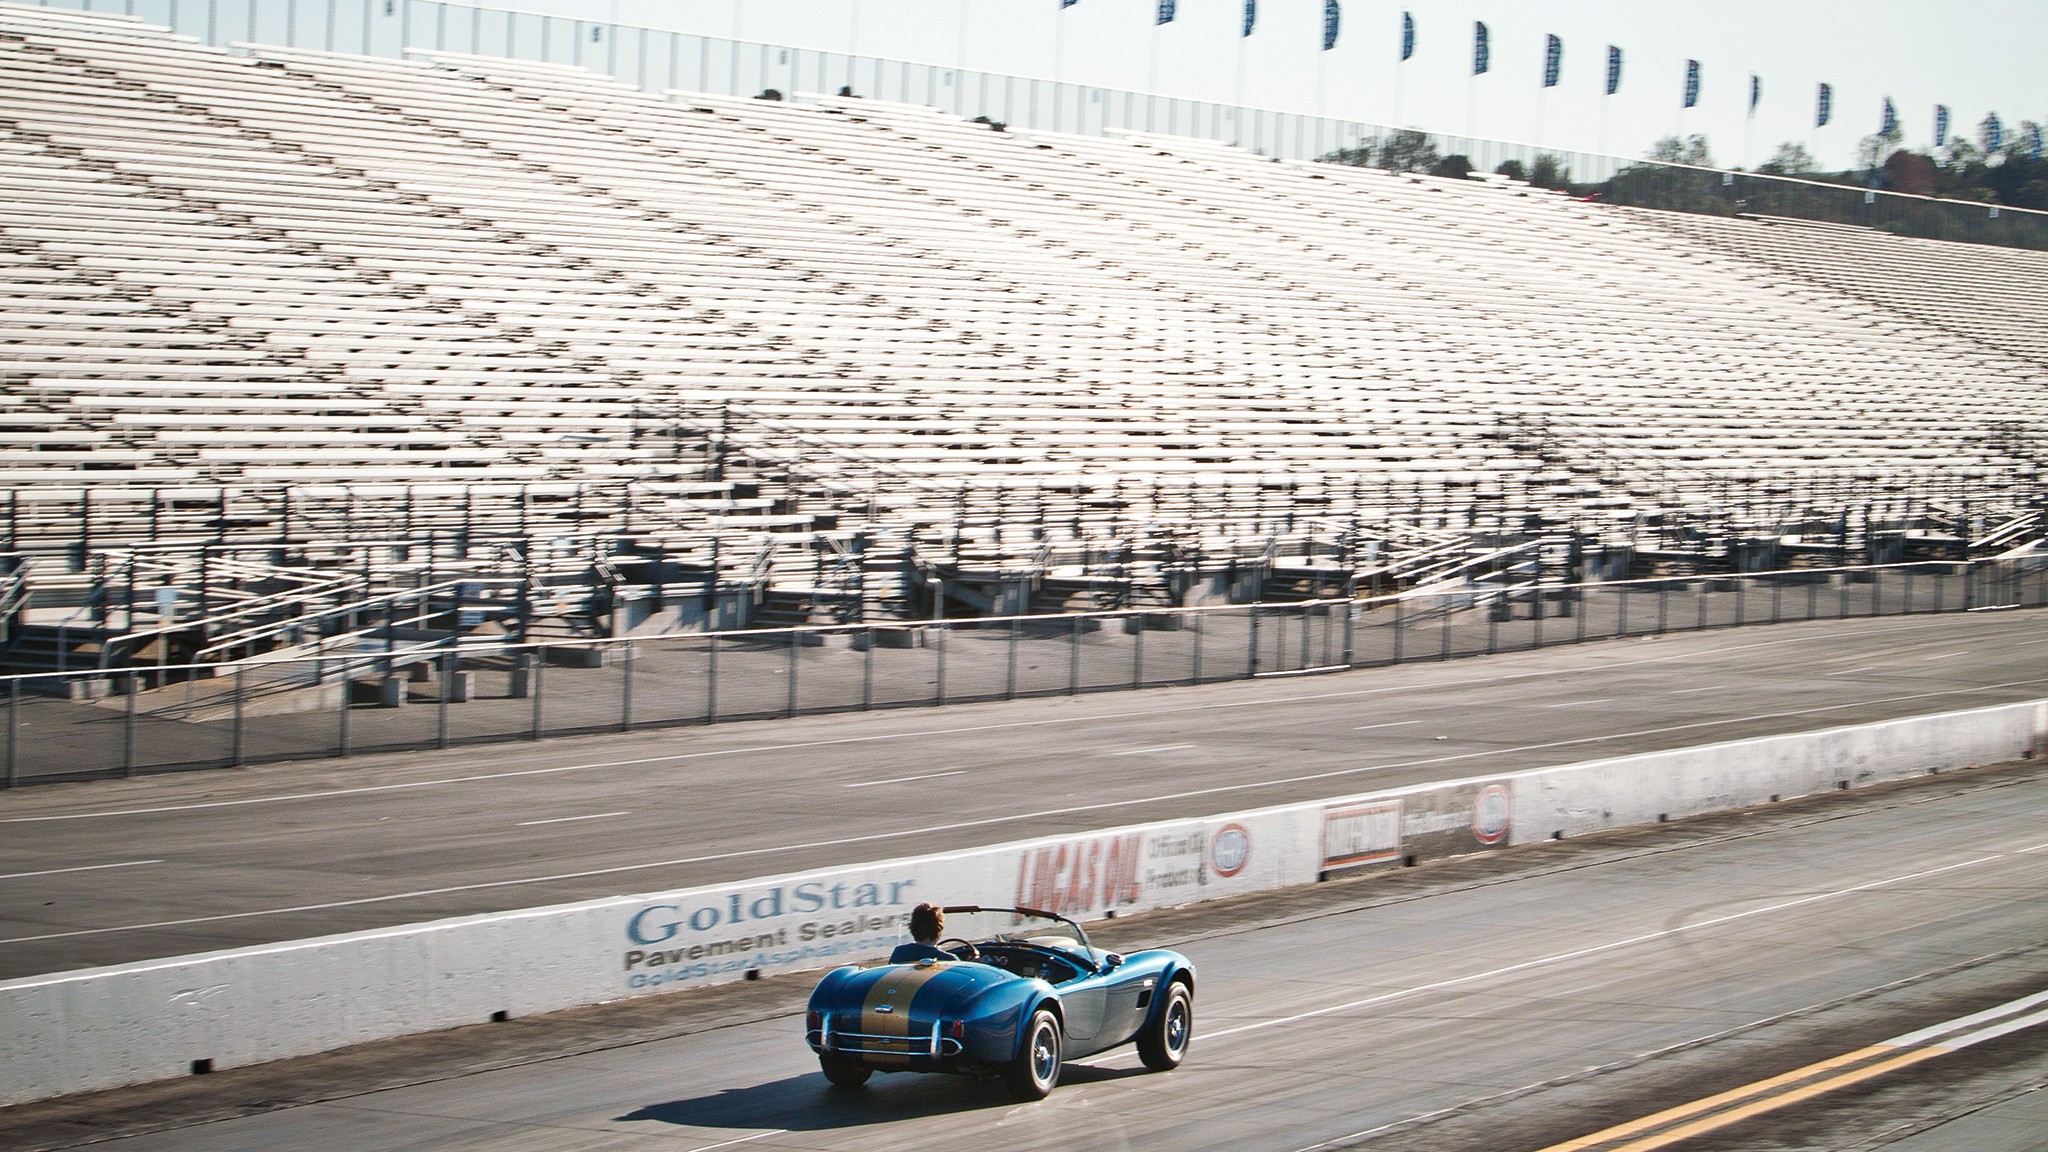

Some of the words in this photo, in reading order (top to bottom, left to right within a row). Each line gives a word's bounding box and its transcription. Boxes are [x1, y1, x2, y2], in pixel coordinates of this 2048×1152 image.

[624, 928, 788, 971] Pavement
[798, 911, 912, 942] Sealers
[627, 879, 914, 946] GoldStar
